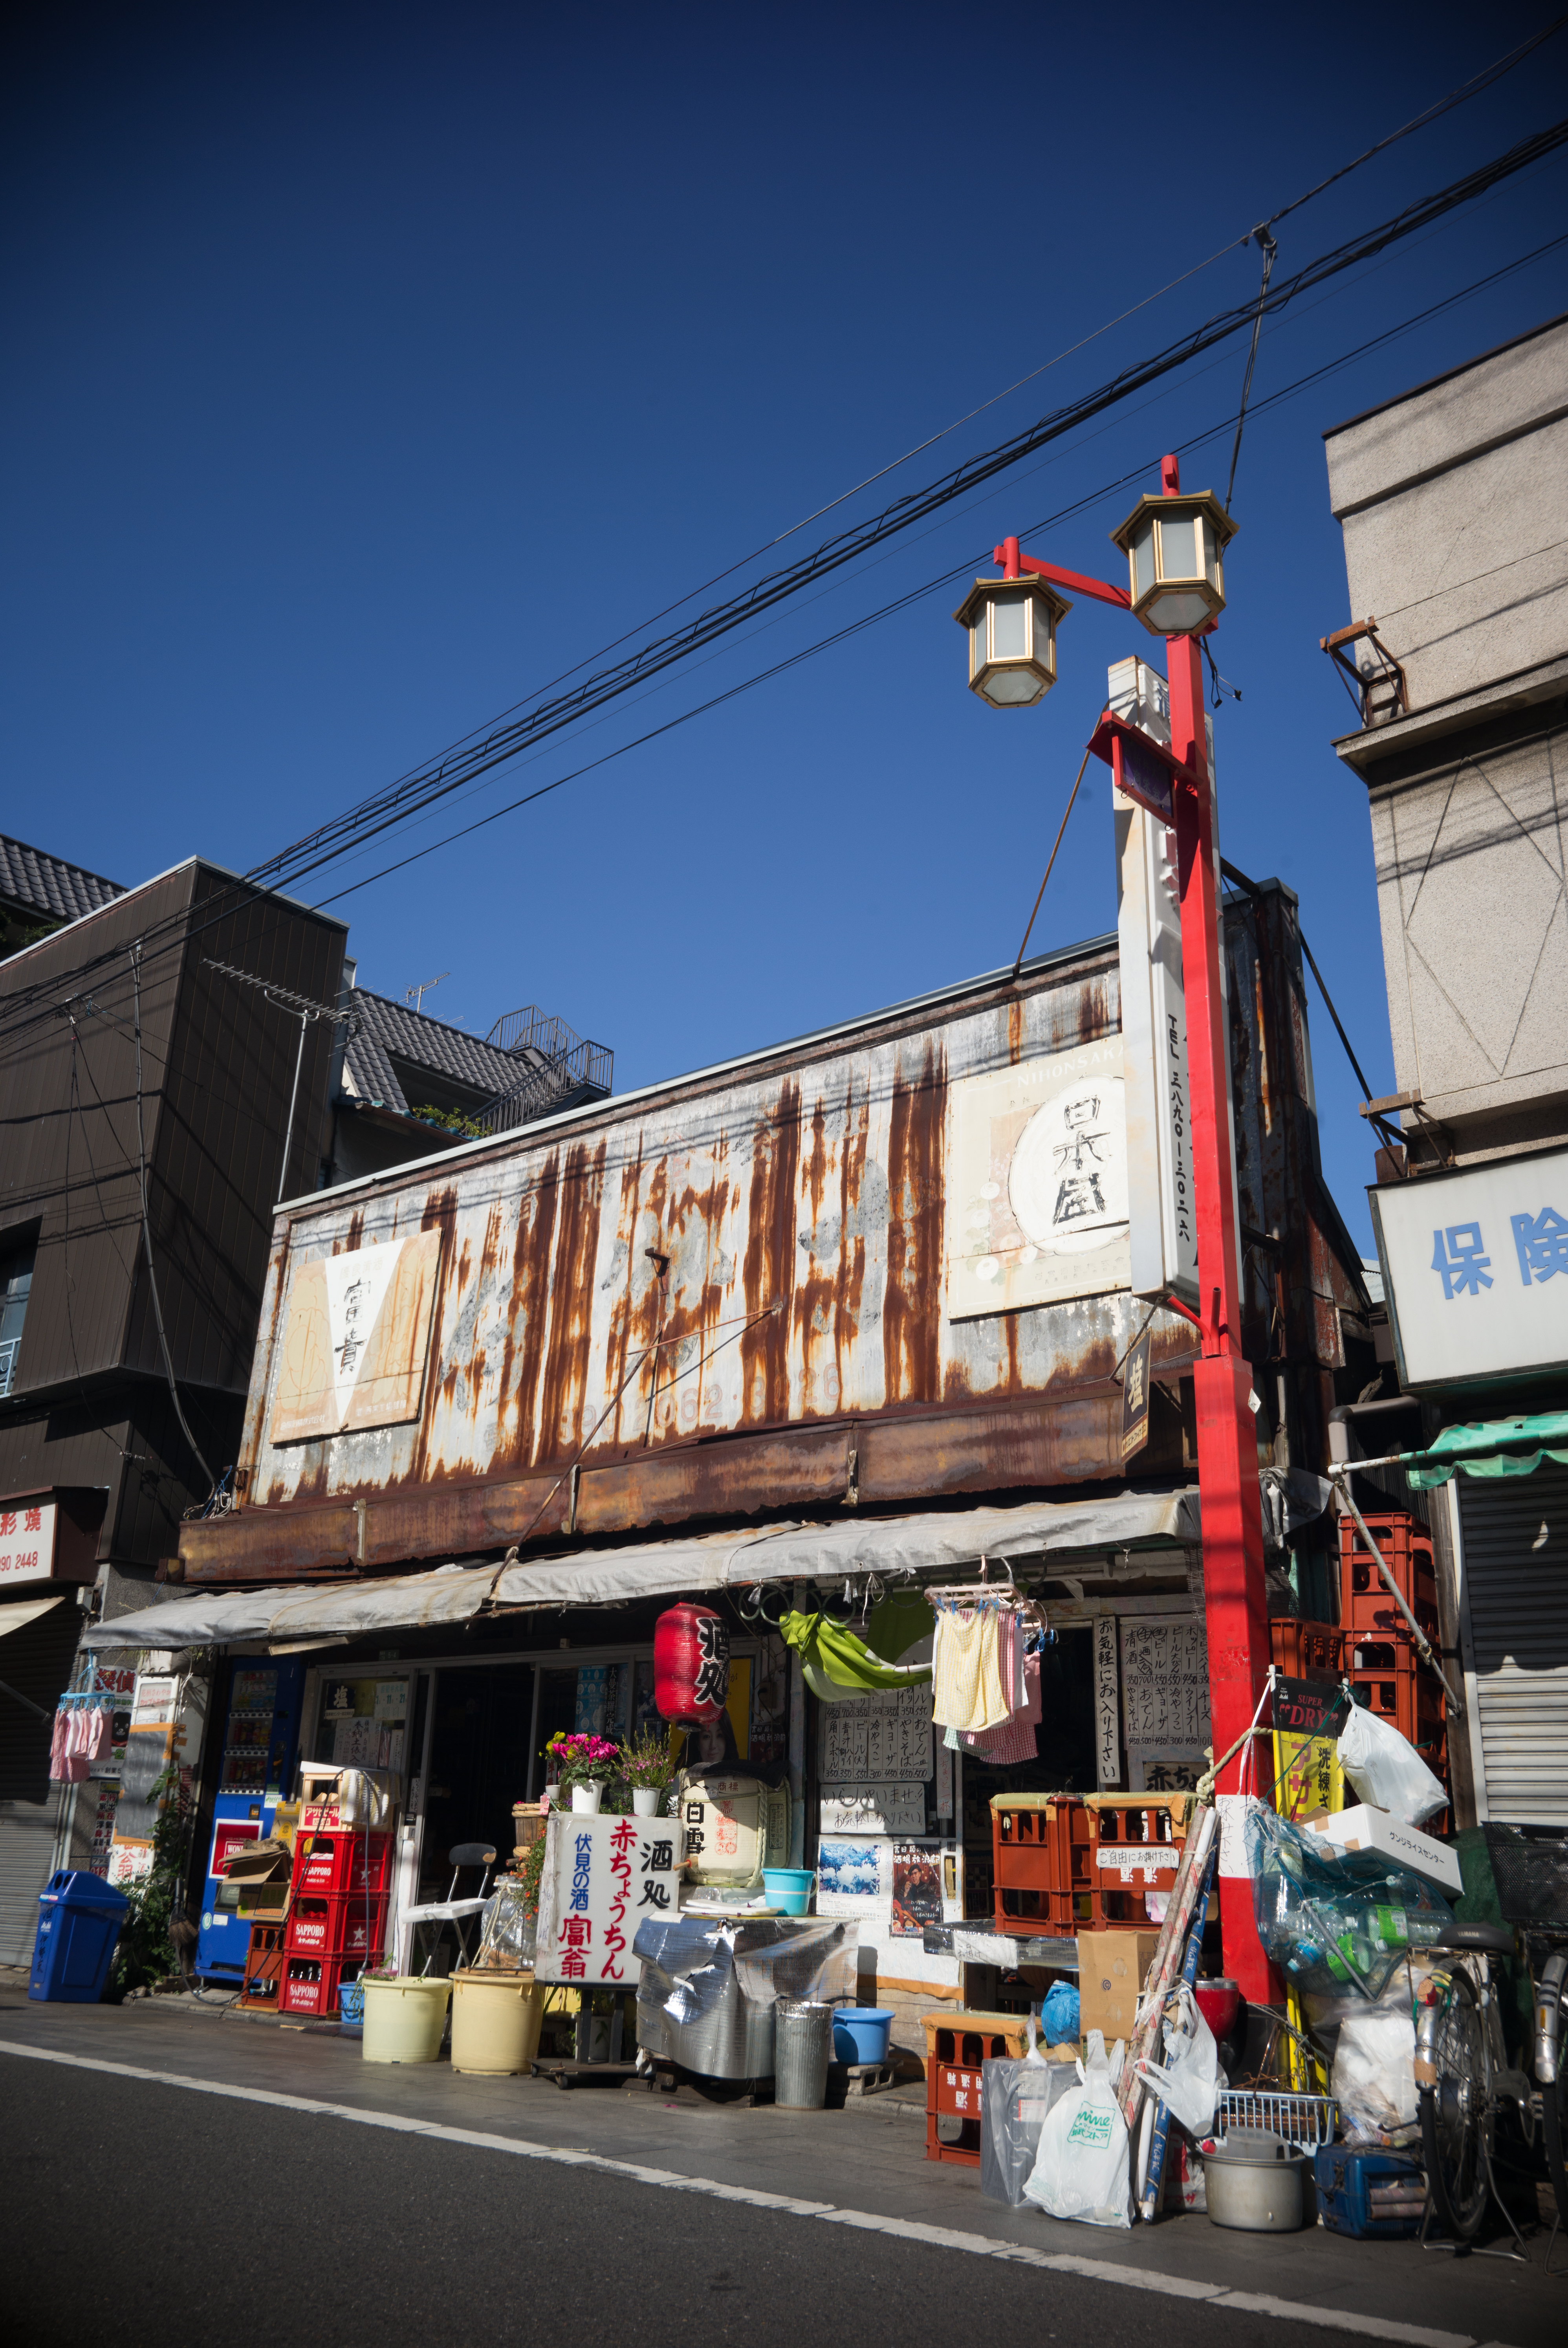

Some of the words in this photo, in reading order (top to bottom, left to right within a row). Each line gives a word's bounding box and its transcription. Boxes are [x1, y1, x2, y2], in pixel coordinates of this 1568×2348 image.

[1128, 1353, 1143, 1412] 塩
[15, 1551, 38, 1570] 2448
[1126, 1629, 1138, 1665] 清酒
[1185, 1626, 1197, 1670] ホッピー
[95, 1668, 136, 1694] 探偵
[1127, 1675, 1138, 1685] 350
[1139, 1675, 1152, 1686] 700
[1154, 1675, 1167, 1685] 550
[1167, 1675, 1181, 1685] 550
[1182, 1675, 1197, 1685] 450
[333, 1685, 348, 1708] 塩
[1098, 1620, 1116, 1778] お気軽にお入り下さい
[1127, 1687, 1138, 1732] やきそば
[1139, 1688, 1154, 1730] おでん
[1198, 1689, 1211, 1721] チーズ
[1297, 1694, 1323, 1707] SUPER
[827, 1708, 839, 1718] 450
[854, 1708, 868, 1718] 350
[871, 1706, 882, 1715] 350
[884, 1708, 897, 1717] 350
[901, 1707, 913, 1716] 350
[828, 1721, 839, 1770] 角ハイボール
[899, 1719, 913, 1767] やきそば
[1128, 1737, 1139, 1746] 450
[1139, 1736, 1152, 1745] 500
[1154, 1736, 1167, 1746] 450
[1169, 1736, 1182, 1745] 300
[1185, 1736, 1198, 1746] 450
[717, 1781, 739, 1792] 商標
[839, 1770, 852, 1778] 350
[854, 1770, 868, 1779] 550
[869, 1770, 882, 1778] 300
[885, 1770, 897, 1778] 450
[899, 1769, 913, 1779] 450
[913, 1769, 927, 1778] 500
[1146, 1764, 1202, 1791] 赤ちょ
[686, 1798, 709, 1855] 白雪
[893, 1854, 940, 1865] 酒場放浪記
[1099, 1849, 1176, 1865] ご自由にお掛け下さい
[1389, 1831, 1445, 1864] グンジライスセンター
[308, 1867, 331, 1876] SAPPORO
[569, 1833, 592, 1911] 伏見の酒
[636, 1839, 674, 1910] 酒処
[600, 1818, 638, 1979] 赤ちょうちん
[295, 1924, 325, 1937] SAPPORO
[557, 1913, 592, 1979] 富翁
[1185, 1945, 1198, 1971] フルホワイト
[289, 1984, 318, 1999] SAPPORO
